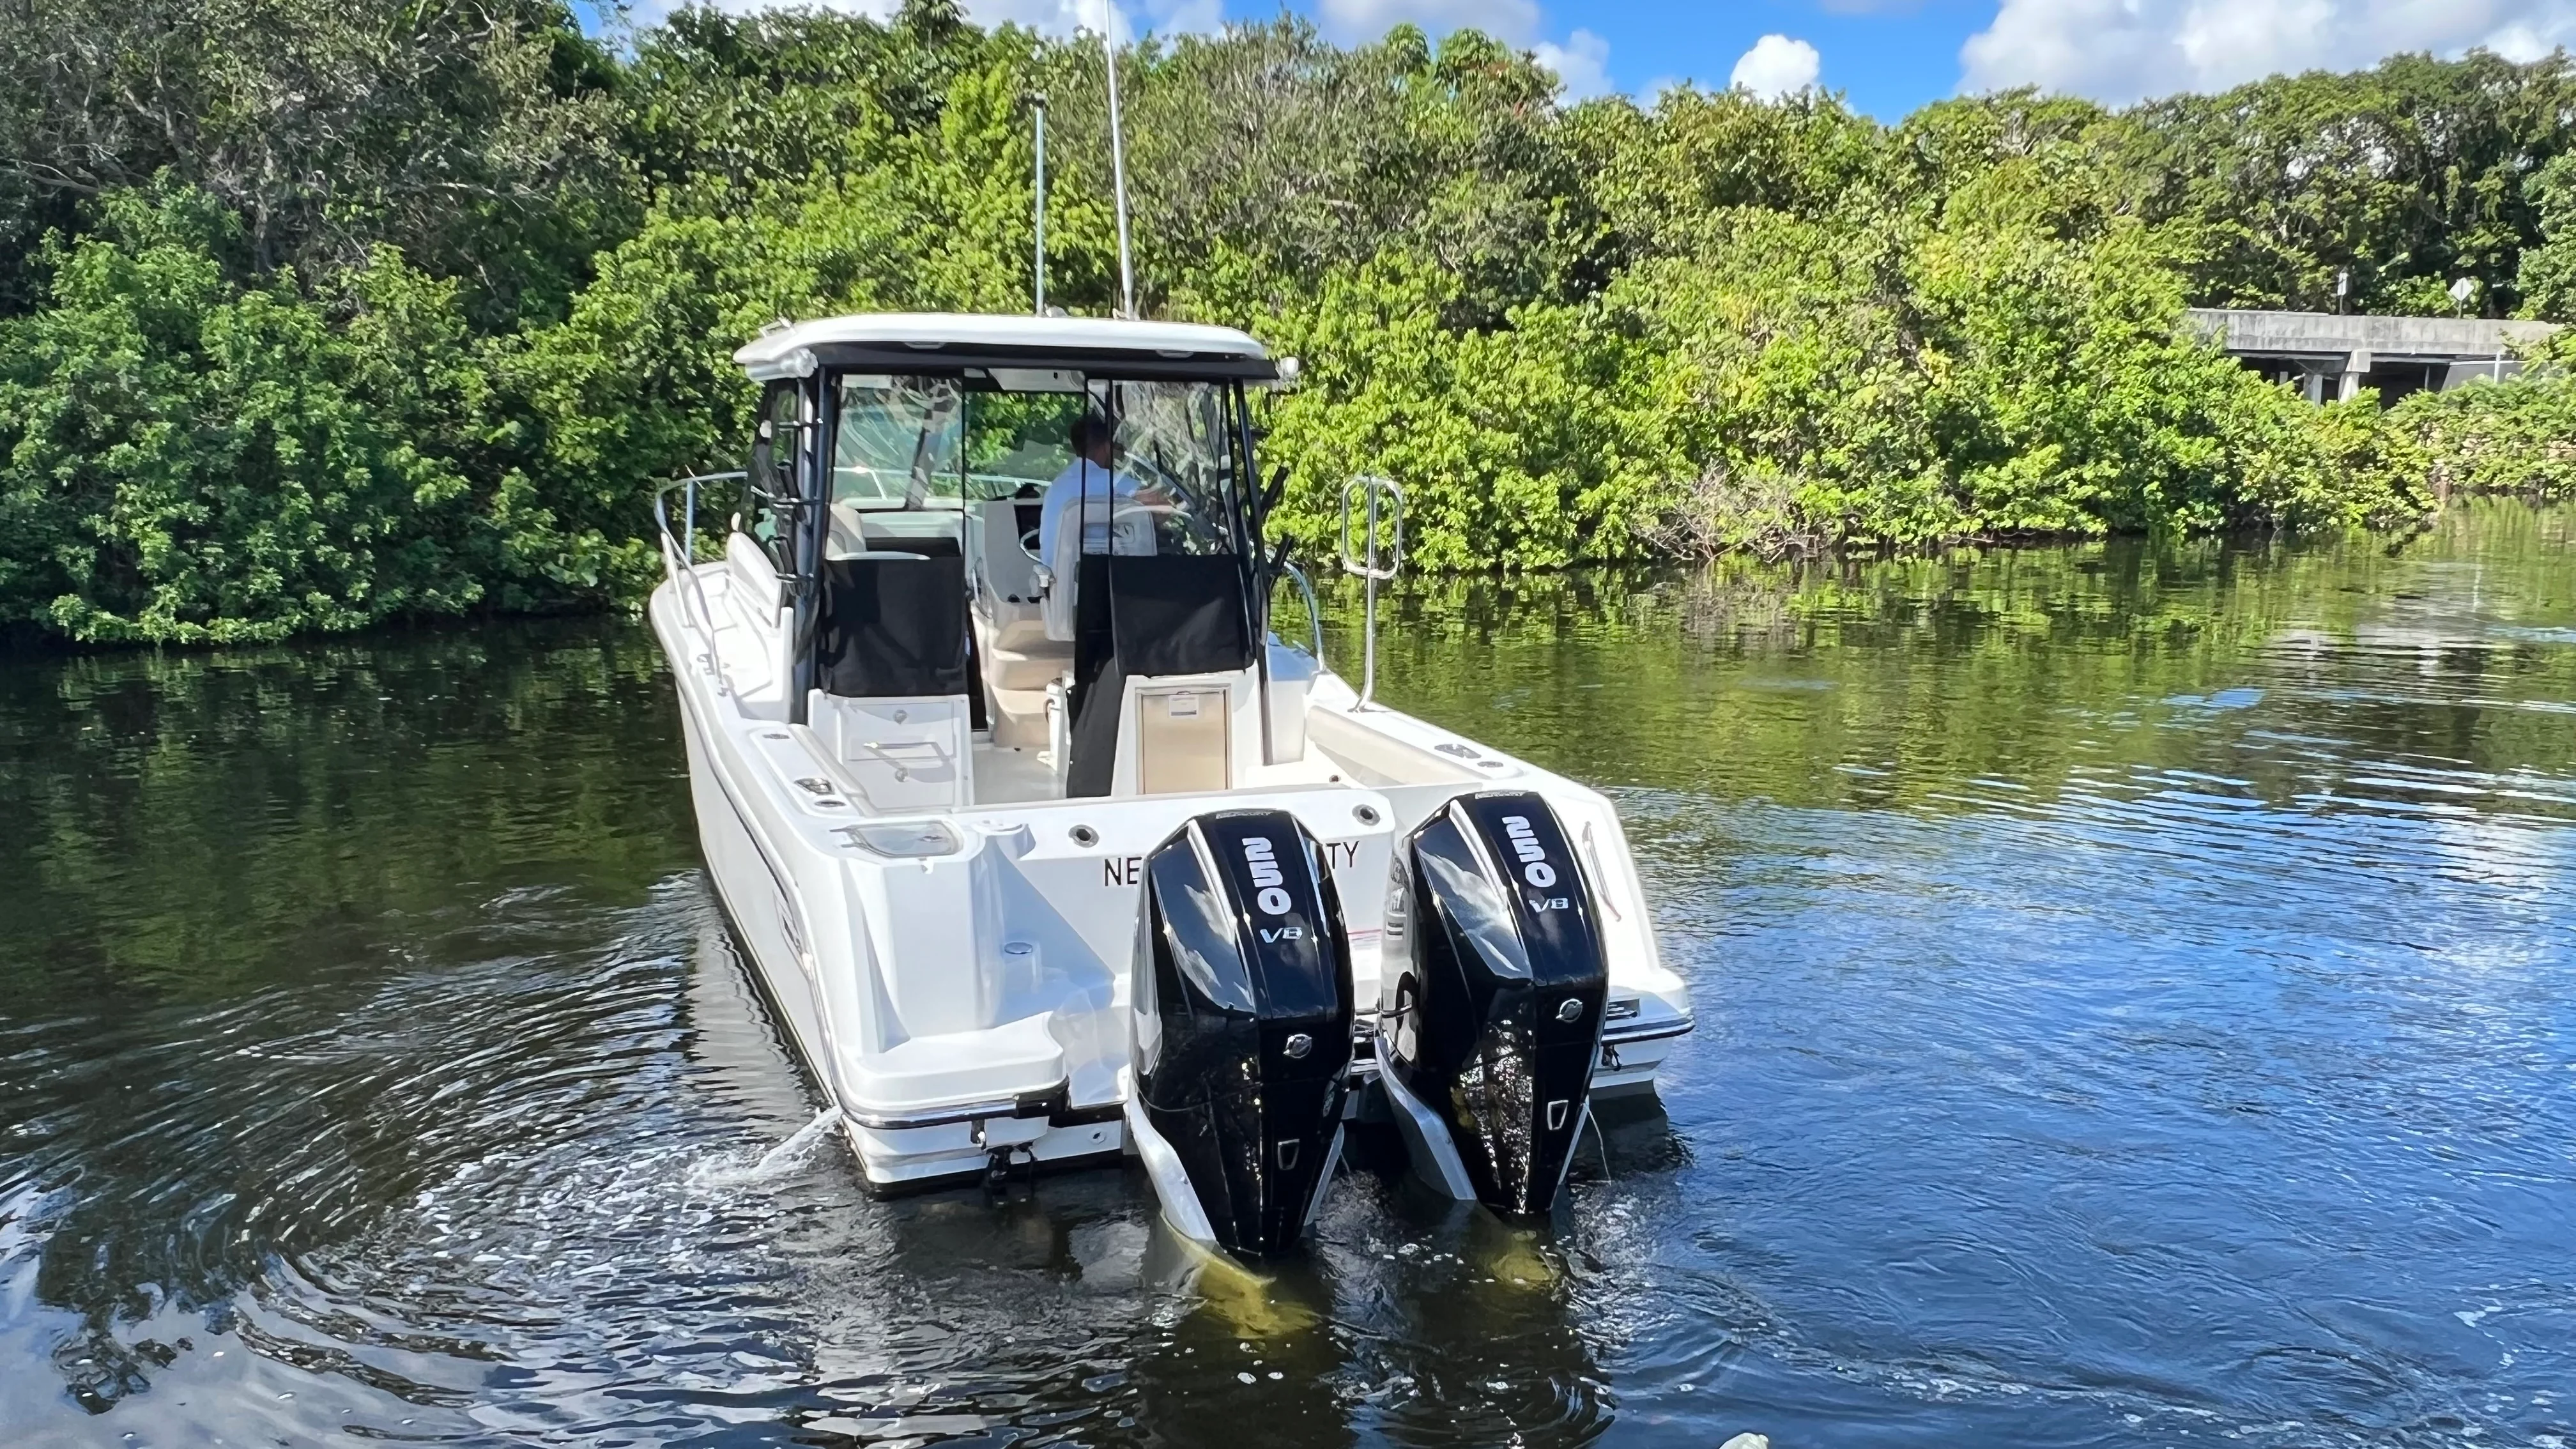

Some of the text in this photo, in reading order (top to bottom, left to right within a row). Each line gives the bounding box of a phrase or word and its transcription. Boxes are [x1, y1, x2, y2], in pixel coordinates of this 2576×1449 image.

[1105, 840, 1360, 887] NE TY
[1501, 816, 1556, 887] 250
[1241, 837, 1292, 915] 250
[1528, 898, 1568, 913] V8
[1259, 926, 1303, 944] V8
